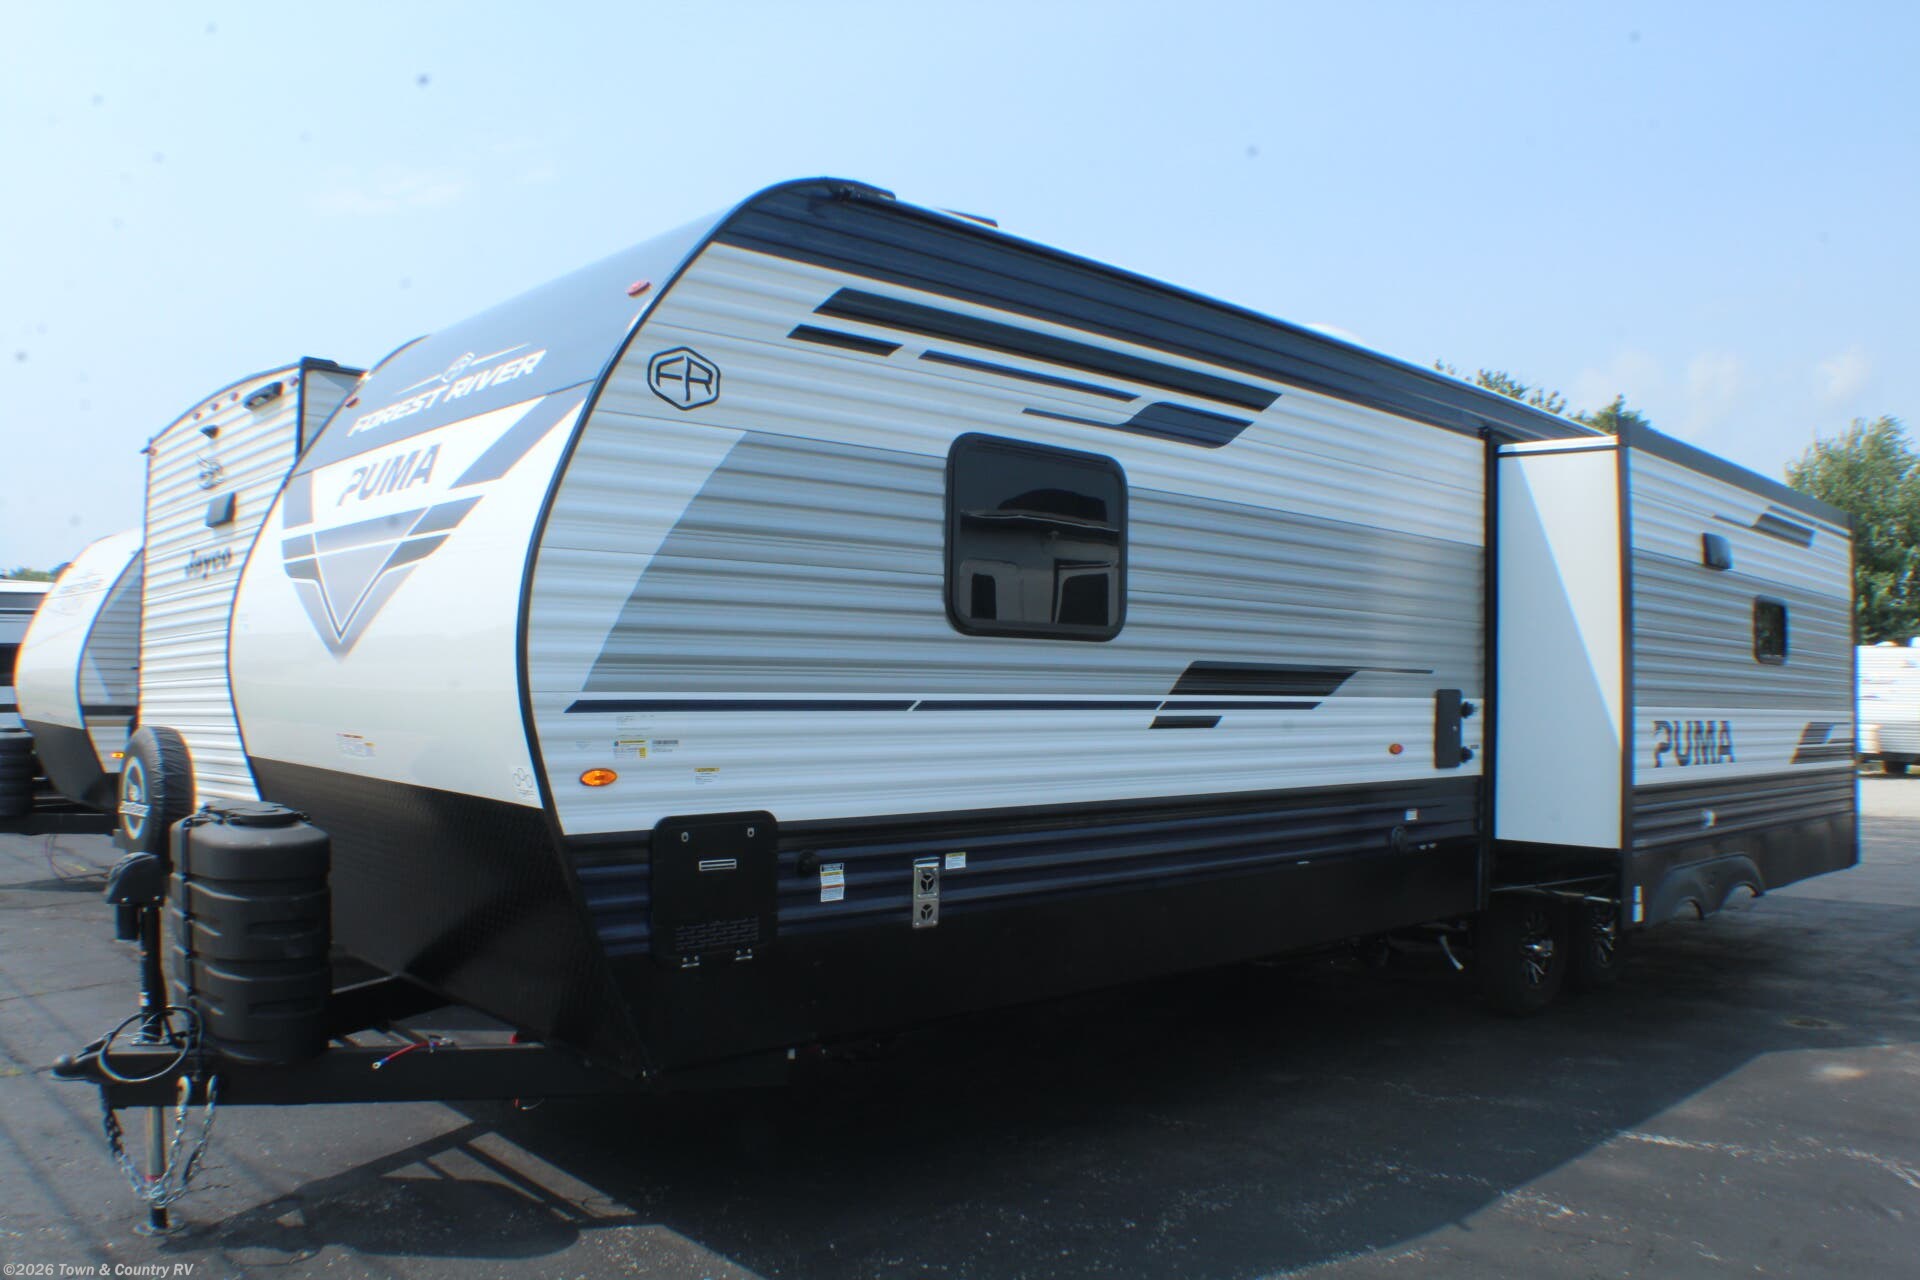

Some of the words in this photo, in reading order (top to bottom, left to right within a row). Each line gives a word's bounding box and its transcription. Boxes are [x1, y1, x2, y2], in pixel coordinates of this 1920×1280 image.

[346, 385, 450, 438] FOREST
[443, 349, 547, 403] RIVER
[336, 443, 441, 507] PUMA
[184, 547, 232, 579] Jayco
[1652, 720, 1736, 768] PUMA
